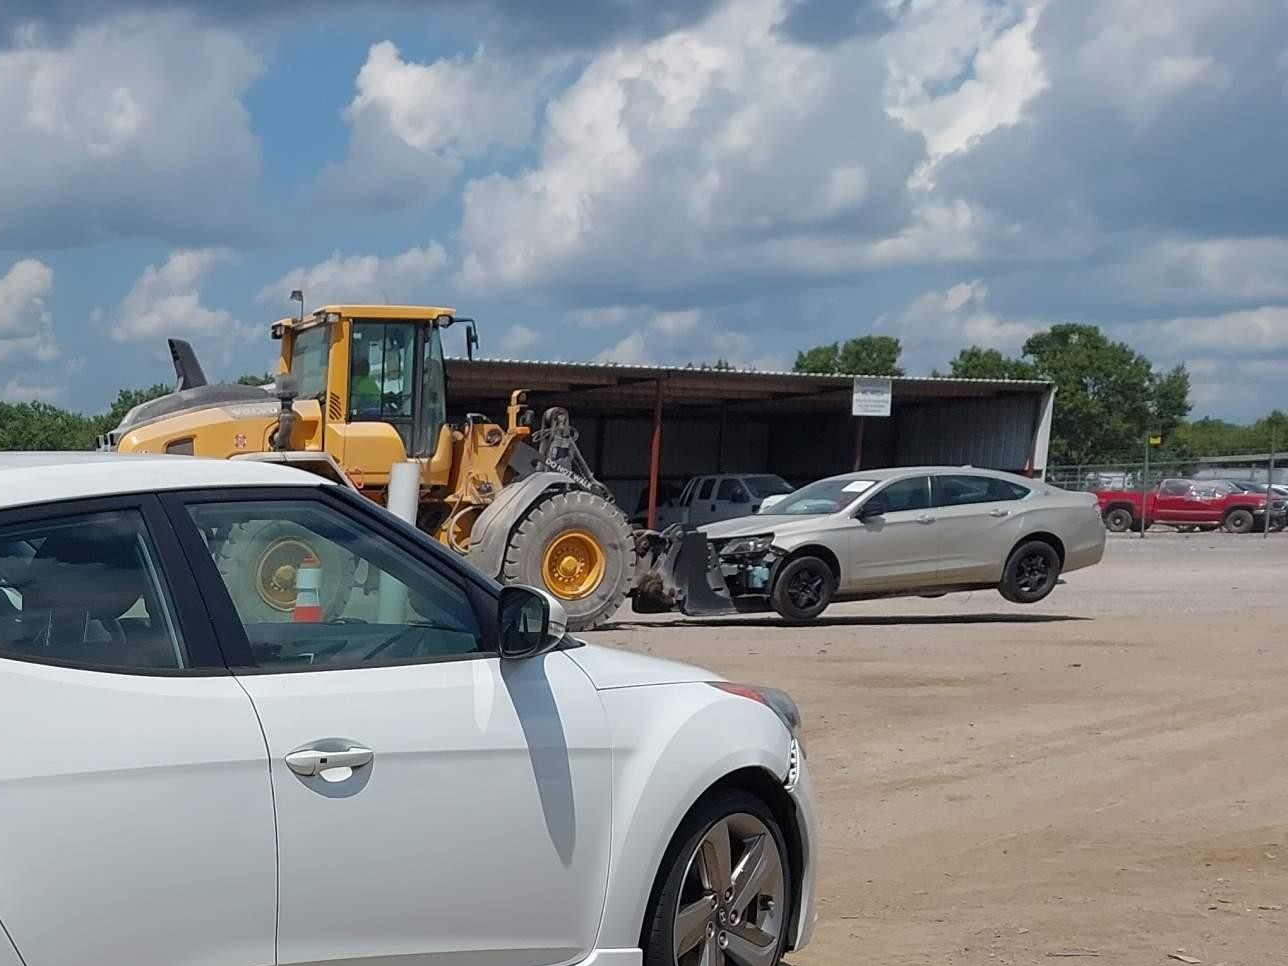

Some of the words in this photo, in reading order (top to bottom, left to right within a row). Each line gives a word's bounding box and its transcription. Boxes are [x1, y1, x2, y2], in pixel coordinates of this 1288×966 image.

[231, 407, 278, 416] VOLVO
[545, 458, 557, 469] DO
[557, 465, 574, 478] NOT
[573, 474, 593, 491] WALK
